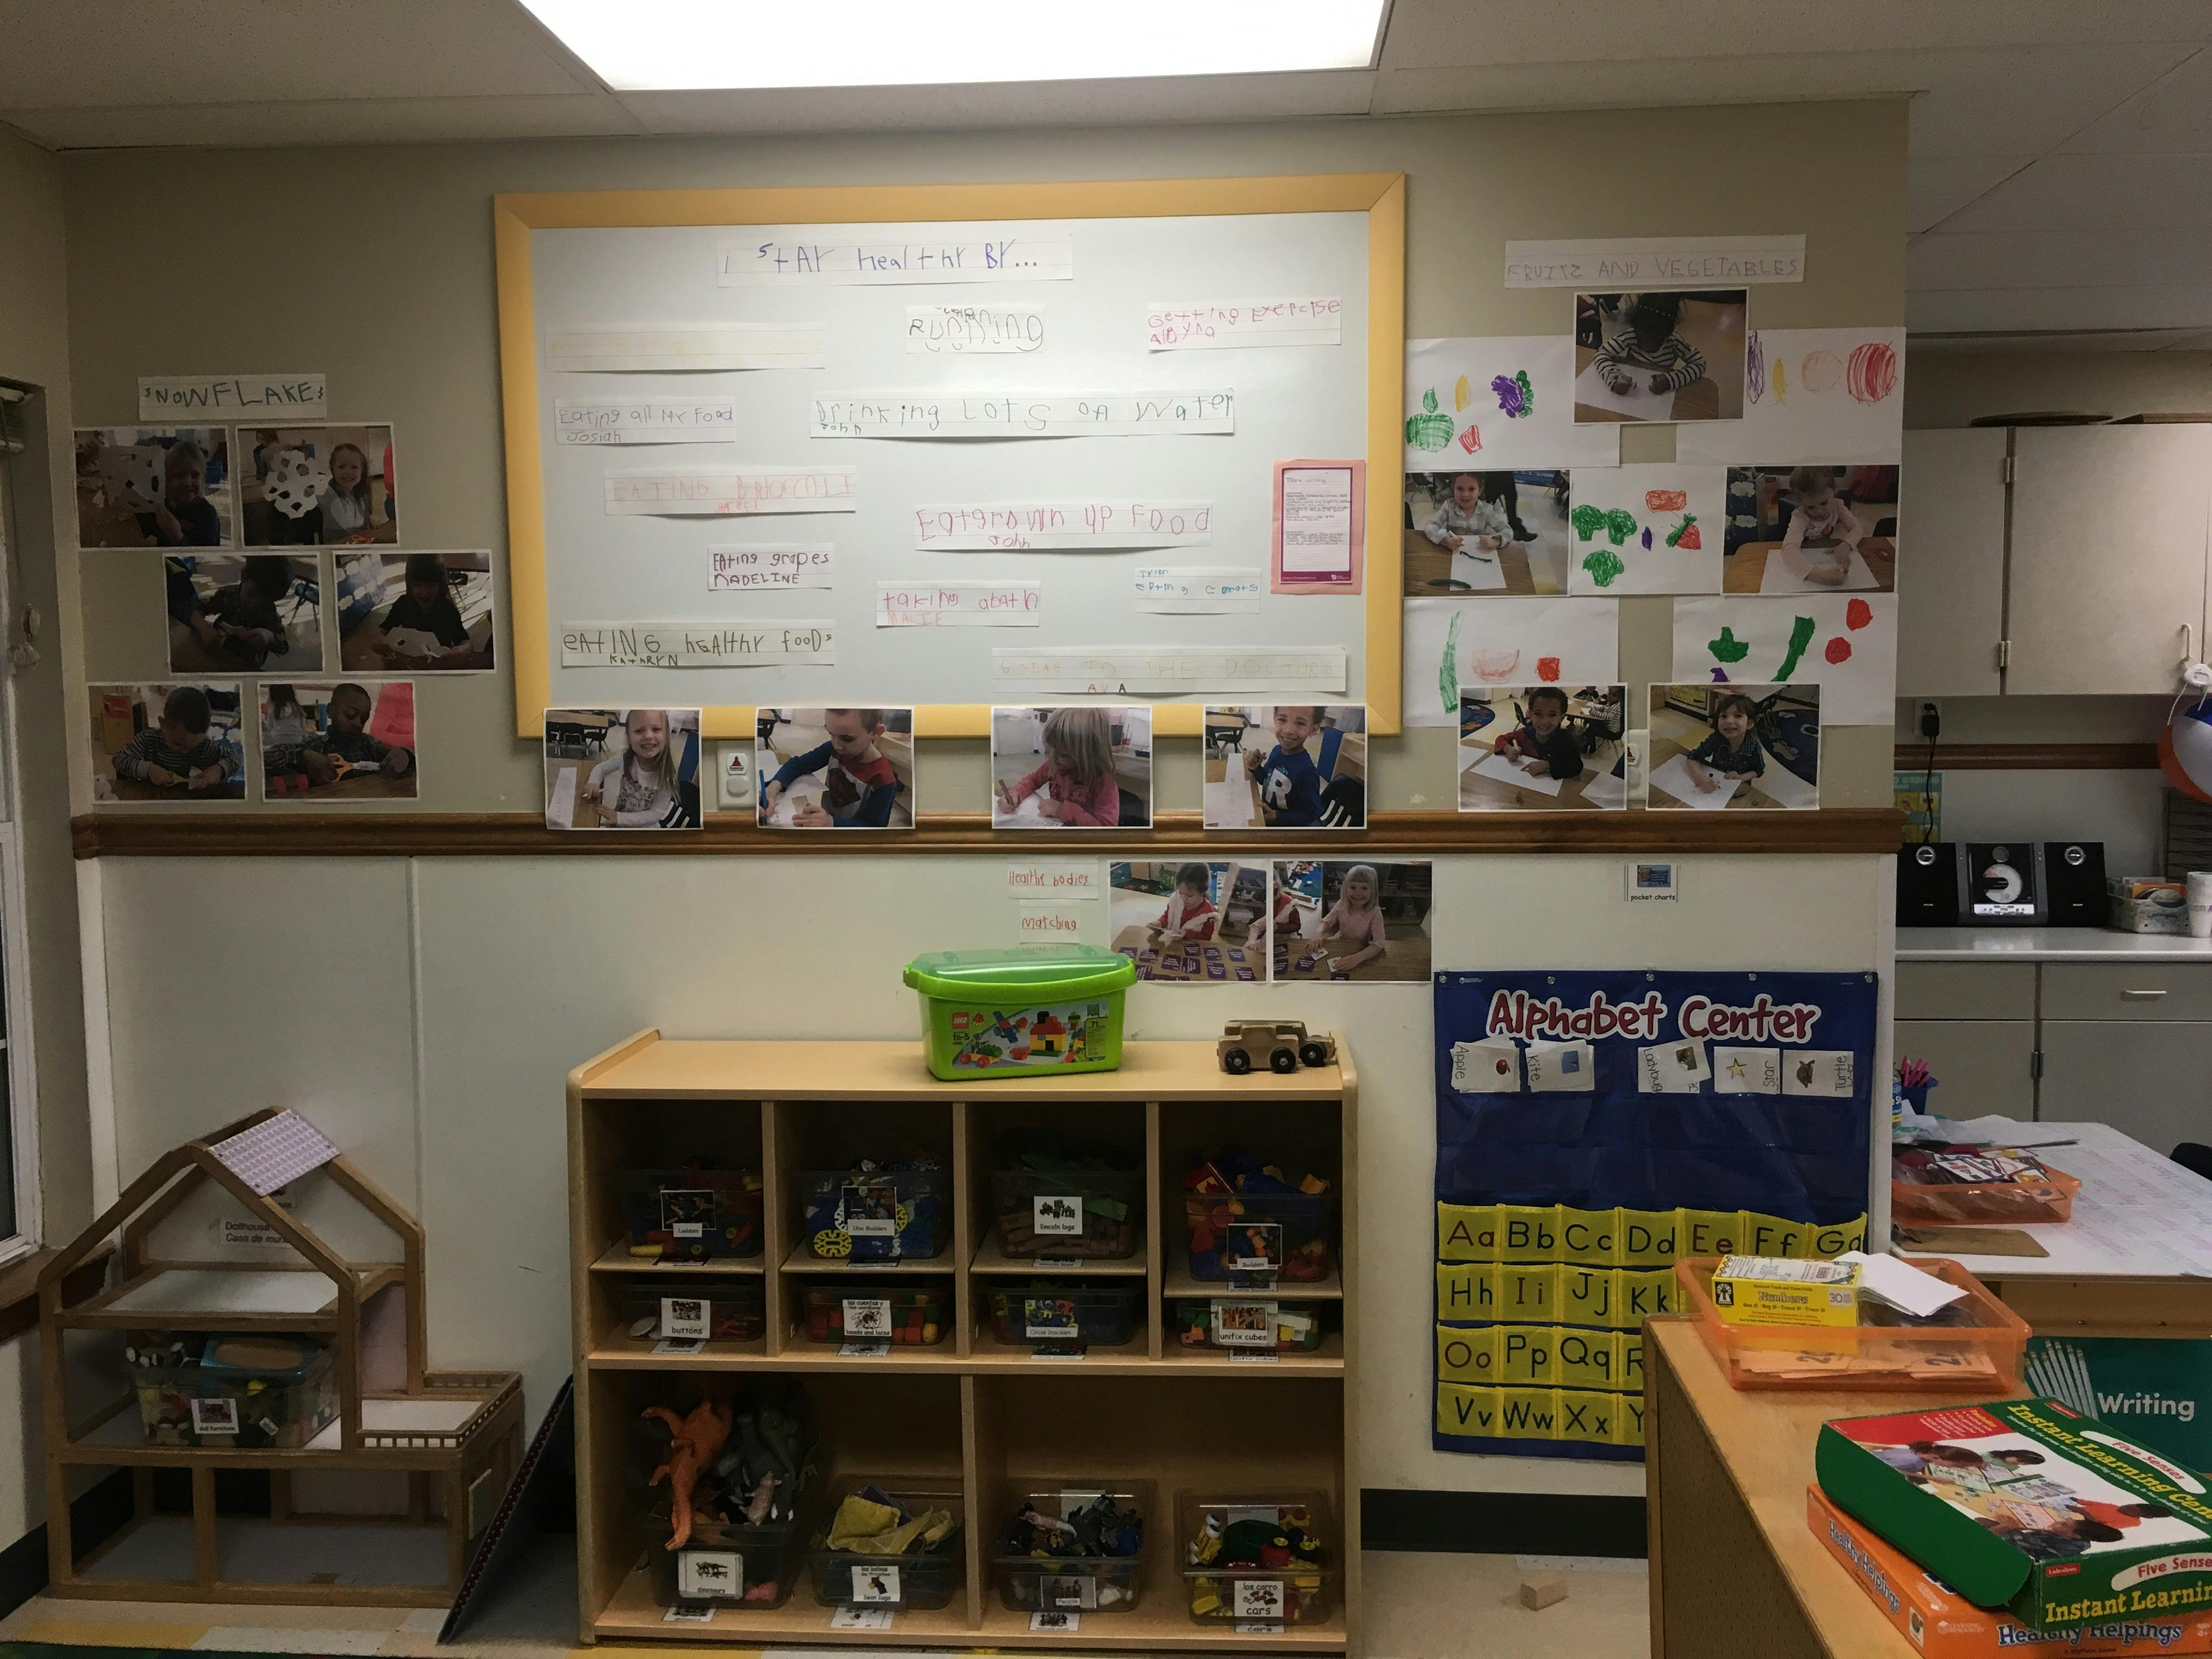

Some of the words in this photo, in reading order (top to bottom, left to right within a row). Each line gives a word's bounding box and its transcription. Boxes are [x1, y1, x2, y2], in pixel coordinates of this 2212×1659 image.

[1598, 260, 1640, 278] AND
[1655, 256, 1798, 277] VEGETABLES
[769, 552, 829, 573] grapes
[1265, 768, 1293, 810] R
[1488, 991, 1664, 1037] Alphabet
[1682, 997, 1818, 1038] Center
[1454, 1045, 1469, 1080] Apple
[1527, 1055, 1541, 1082] Kite
[1643, 1048, 1663, 1093] Ladybug
[1764, 1060, 1776, 1087] Star
[1835, 1056, 1848, 1091] Turtle
[226, 1233, 249, 1242] Casa
[251, 1234, 263, 1243] de
[1062, 1223, 1075, 1232] logs
[1447, 1220, 1495, 1248] Aa
[1508, 1221, 1555, 1249] Bb
[1565, 1224, 1612, 1251] Cc
[1629, 1226, 1675, 1254] Dd
[1692, 1224, 1734, 1255] Ee
[1756, 1227, 1798, 1256] Ff
[1452, 1277, 1493, 1306] Hh
[1516, 1277, 1543, 1305] Ii
[1572, 1272, 1609, 1316] Jj
[1631, 1284, 1668, 1314] Kk
[1758, 1291, 1809, 1304] Numbers
[1829, 1293, 1843, 1303] 30
[671, 1326, 702, 1335] buttons
[1444, 1341, 1491, 1369] Oo
[1507, 1335, 1547, 1378] Pp
[1560, 1337, 1610, 1380] Qq
[1455, 1396, 1492, 1427] Vv
[1503, 1402, 1554, 1430] Ww
[1565, 1403, 1608, 1435] Xx
[2097, 1391, 2195, 1422] Writing
[2007, 1404, 2084, 1445] Instant
[2074, 1443, 2180, 1493] Learning
[2112, 1441, 2142, 1456] Five
[2142, 1455, 2186, 1481] Senses
[1829, 1517, 1861, 1569] Healthy
[1862, 1550, 1900, 1614] Helpings
[2137, 1565, 2167, 1578] Five
[2045, 1598, 2127, 1623] Instant
[2089, 1621, 2183, 1647] Helpings
